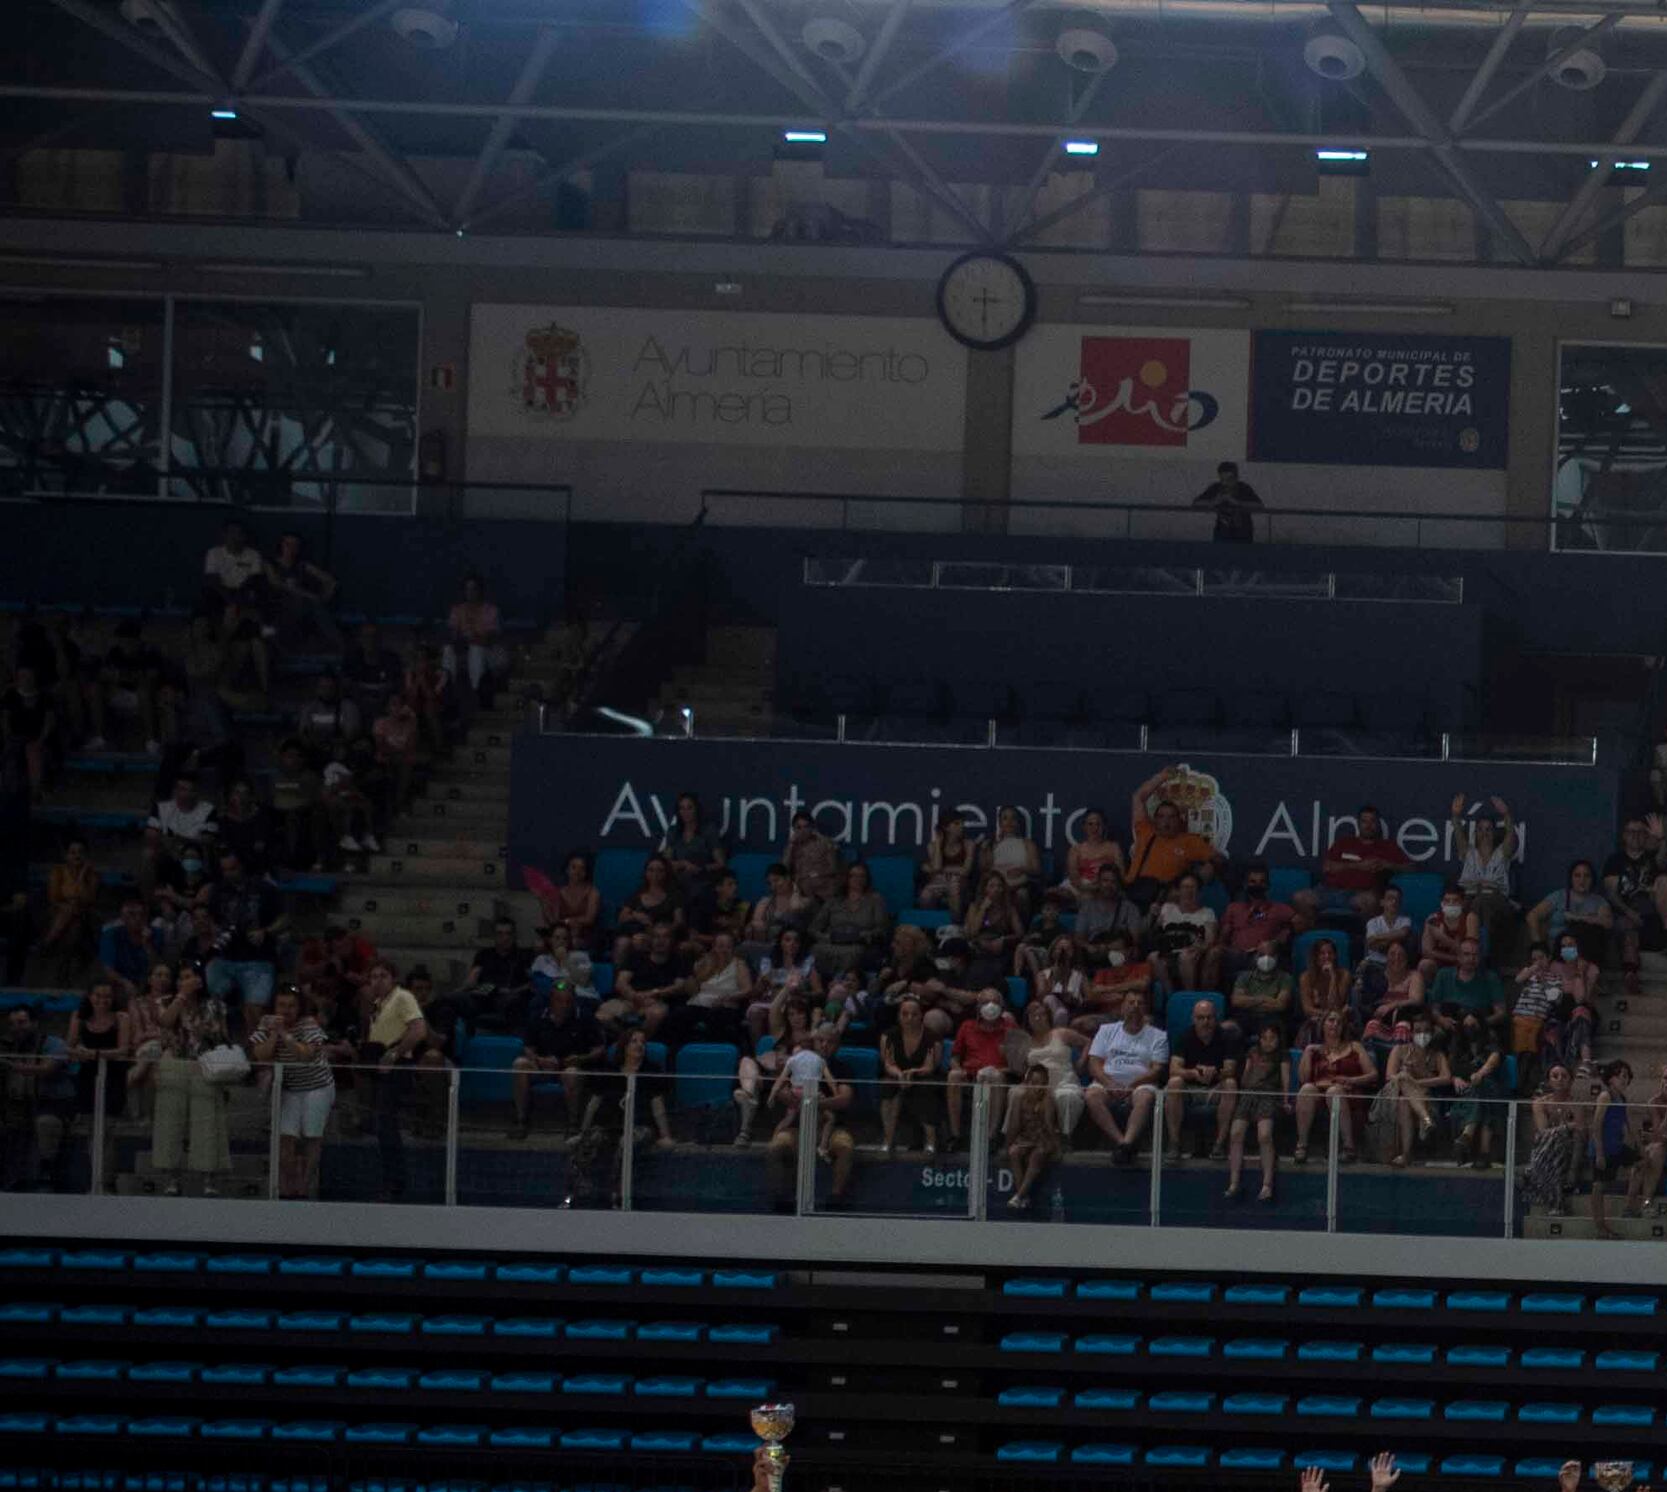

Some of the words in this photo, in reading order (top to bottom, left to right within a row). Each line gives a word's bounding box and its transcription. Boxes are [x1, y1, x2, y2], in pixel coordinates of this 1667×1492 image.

[632, 335, 929, 384] Ayuntamiento
[1291, 346, 1373, 360] PATRONATO
[1377, 350, 1448, 362] MUNICIPAL
[1452, 352, 1472, 362] DE
[1292, 360, 1475, 388] DEPORTES
[630, 380, 792, 425] Almería
[1291, 388, 1334, 411] DE
[1340, 389, 1472, 415] ALMERIA
[921, 1167, 972, 1189] Secto
[997, 1168, 1014, 1193] D
